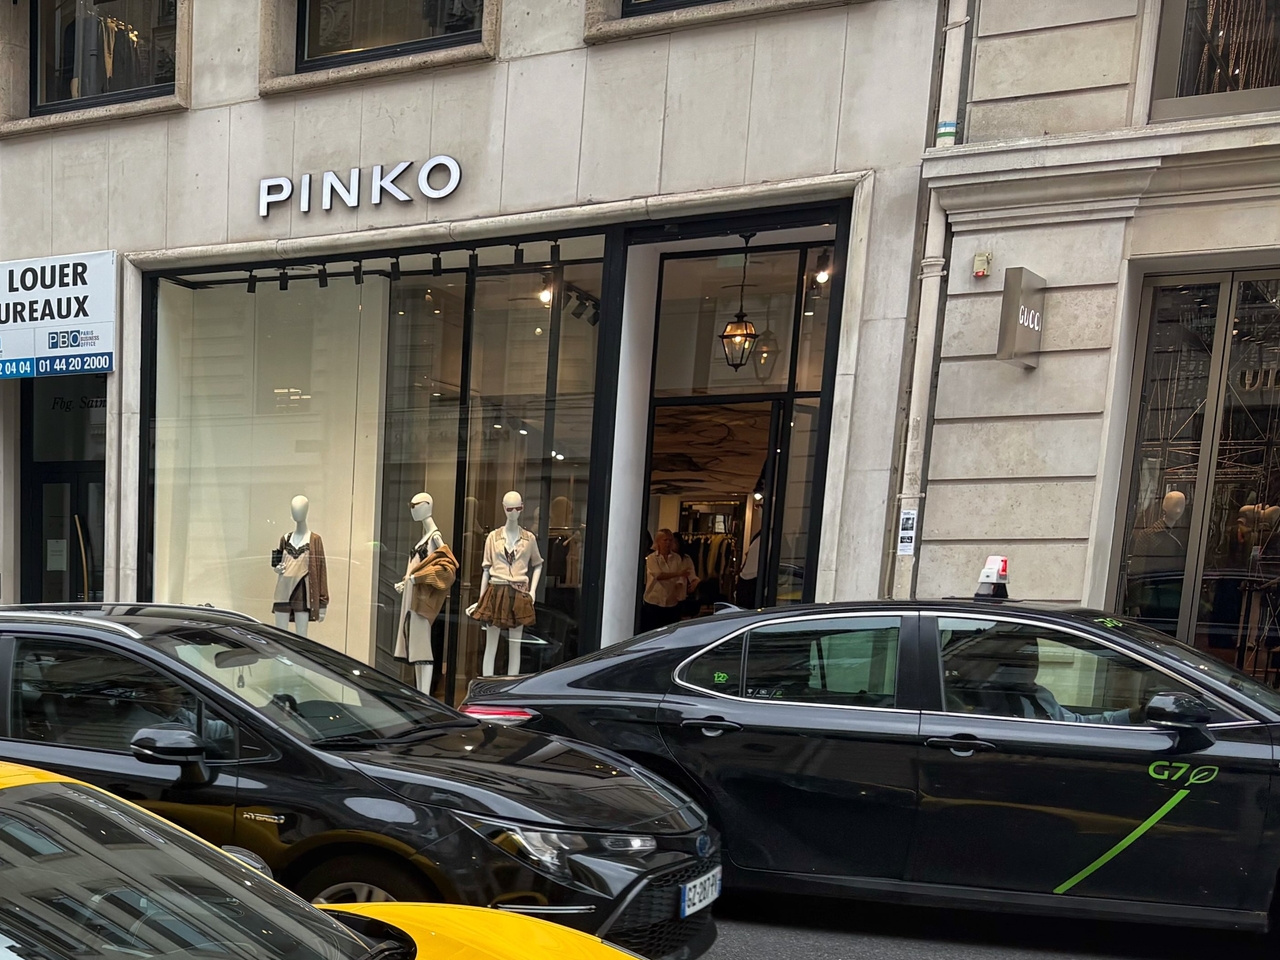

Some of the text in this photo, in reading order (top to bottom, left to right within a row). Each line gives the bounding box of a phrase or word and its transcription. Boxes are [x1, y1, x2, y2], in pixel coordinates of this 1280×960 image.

[258, 154, 462, 217] PINKO
[8, 262, 88, 293] LOUER
[48, 330, 80, 349] PBO
[5, 362, 17, 374] 04
[19, 361, 31, 373] 04
[39, 355, 110, 372] 01 44 20 2000
[51, 397, 74, 412] Fbg.
[1148, 760, 1191, 780] G7
